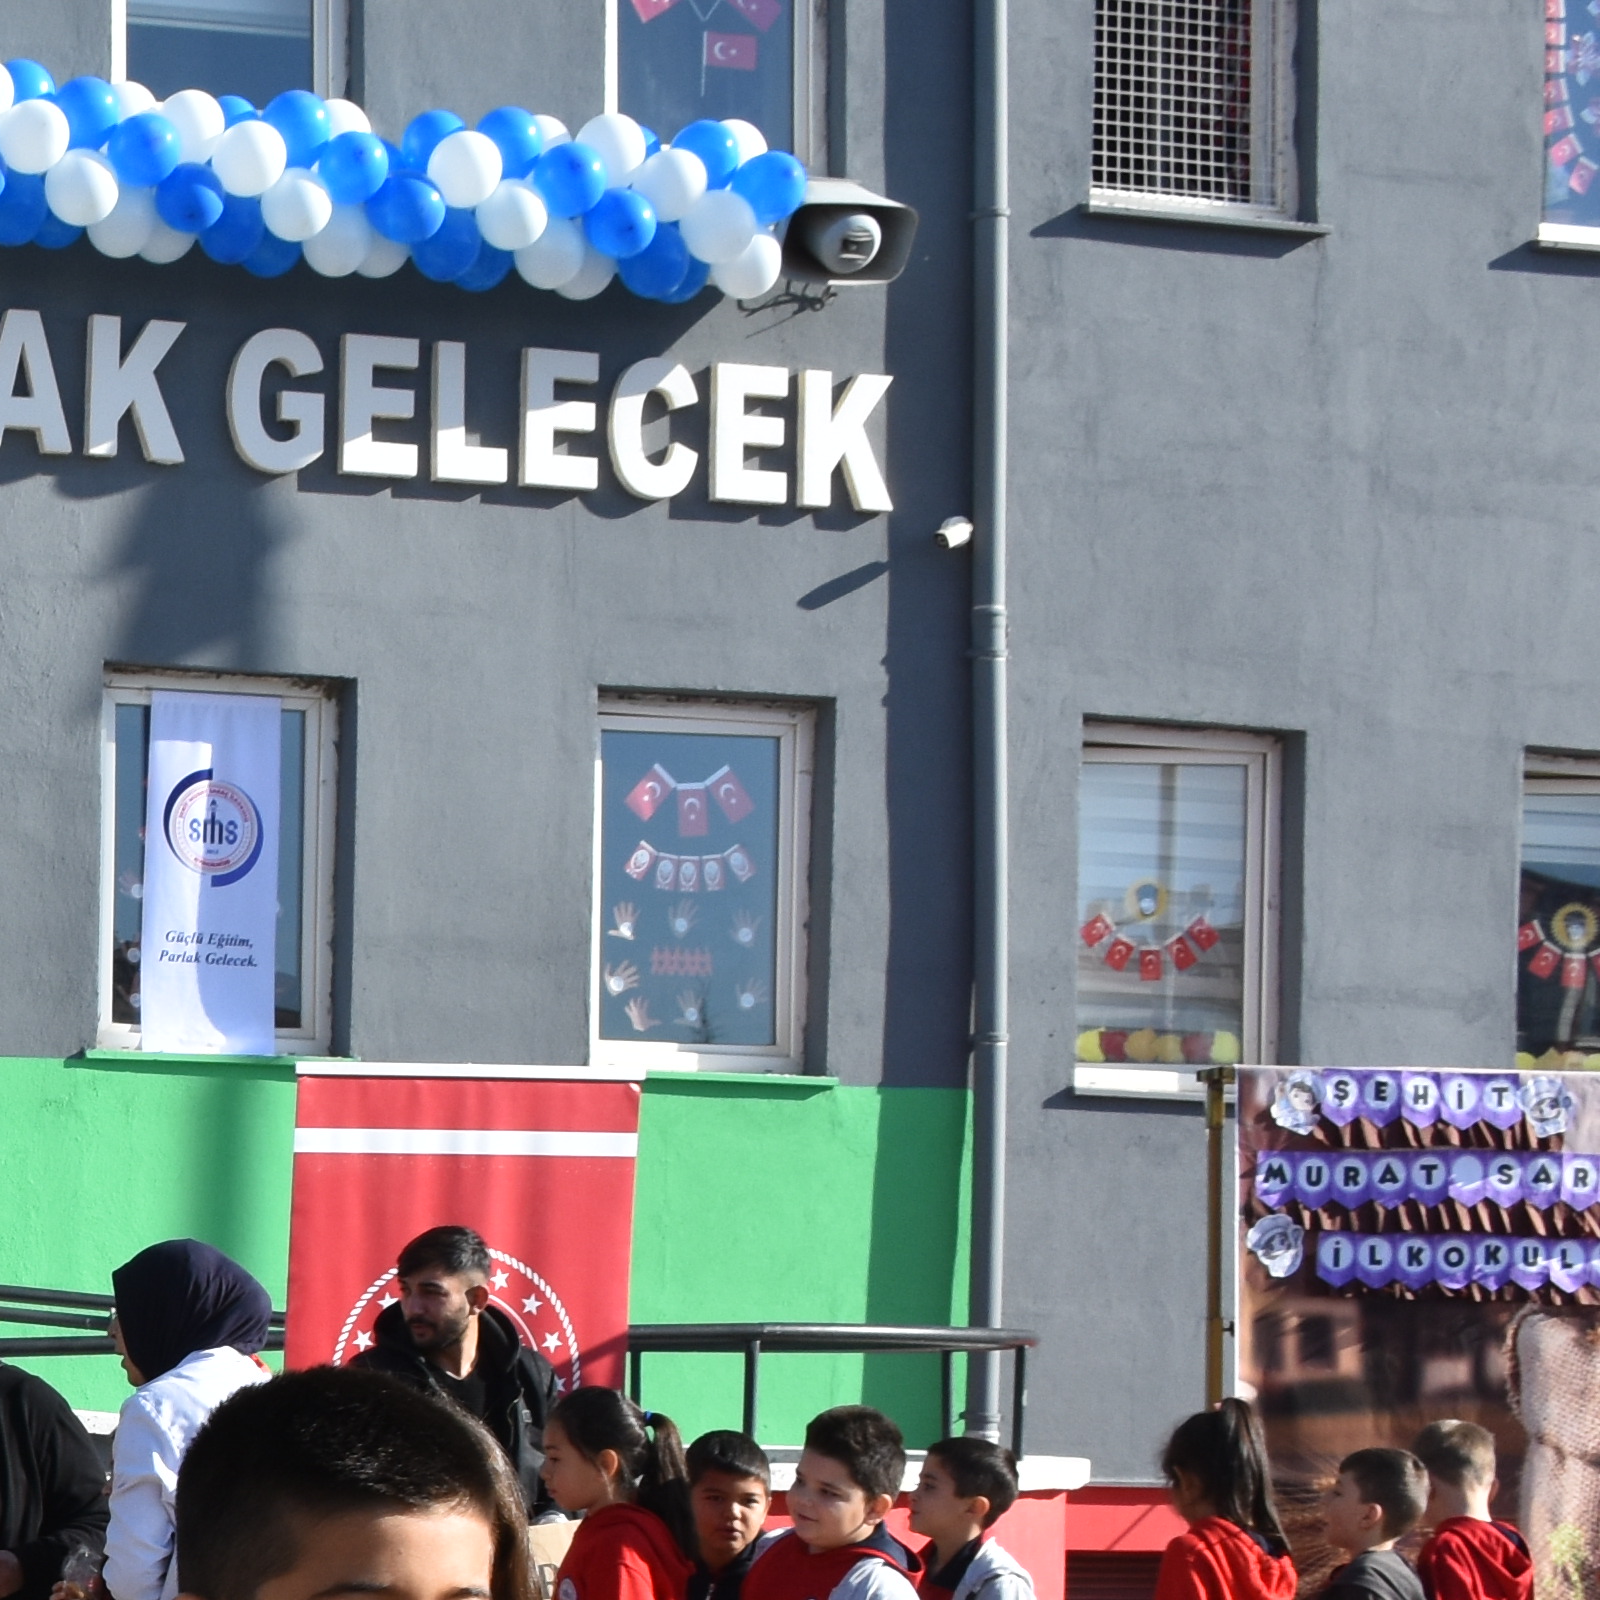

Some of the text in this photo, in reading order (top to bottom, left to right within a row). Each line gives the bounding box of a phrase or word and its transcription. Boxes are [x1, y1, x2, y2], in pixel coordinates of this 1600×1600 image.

[226, 328, 895, 512] GELECEK
[159, 950, 201, 963] Parlak
[1334, 1080, 1509, 1108] ŞEHİT
[1262, 1162, 1439, 1188] MURAT
